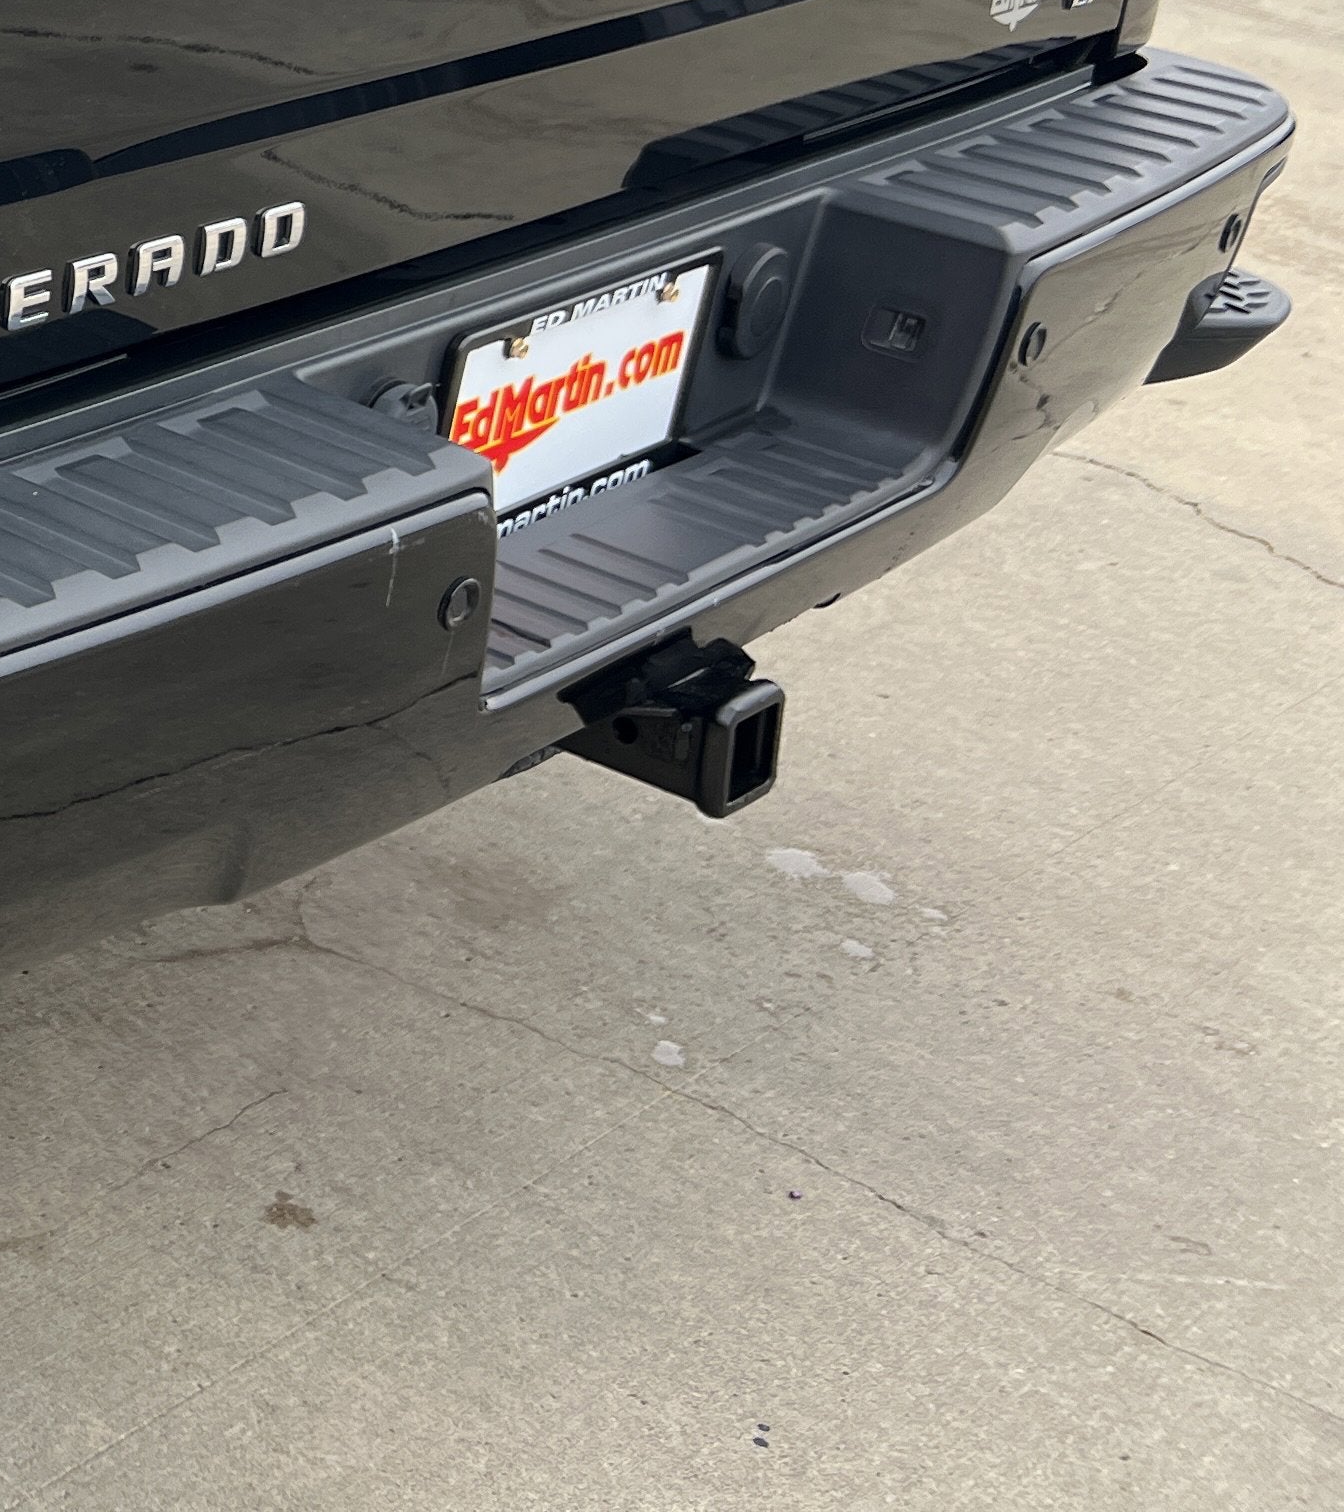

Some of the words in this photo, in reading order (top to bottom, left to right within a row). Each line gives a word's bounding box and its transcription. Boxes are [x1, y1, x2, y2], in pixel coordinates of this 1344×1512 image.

[530, 309, 568, 336] ED
[570, 271, 671, 322] MARTIN
[449, 331, 686, 450] EdMartin.com
